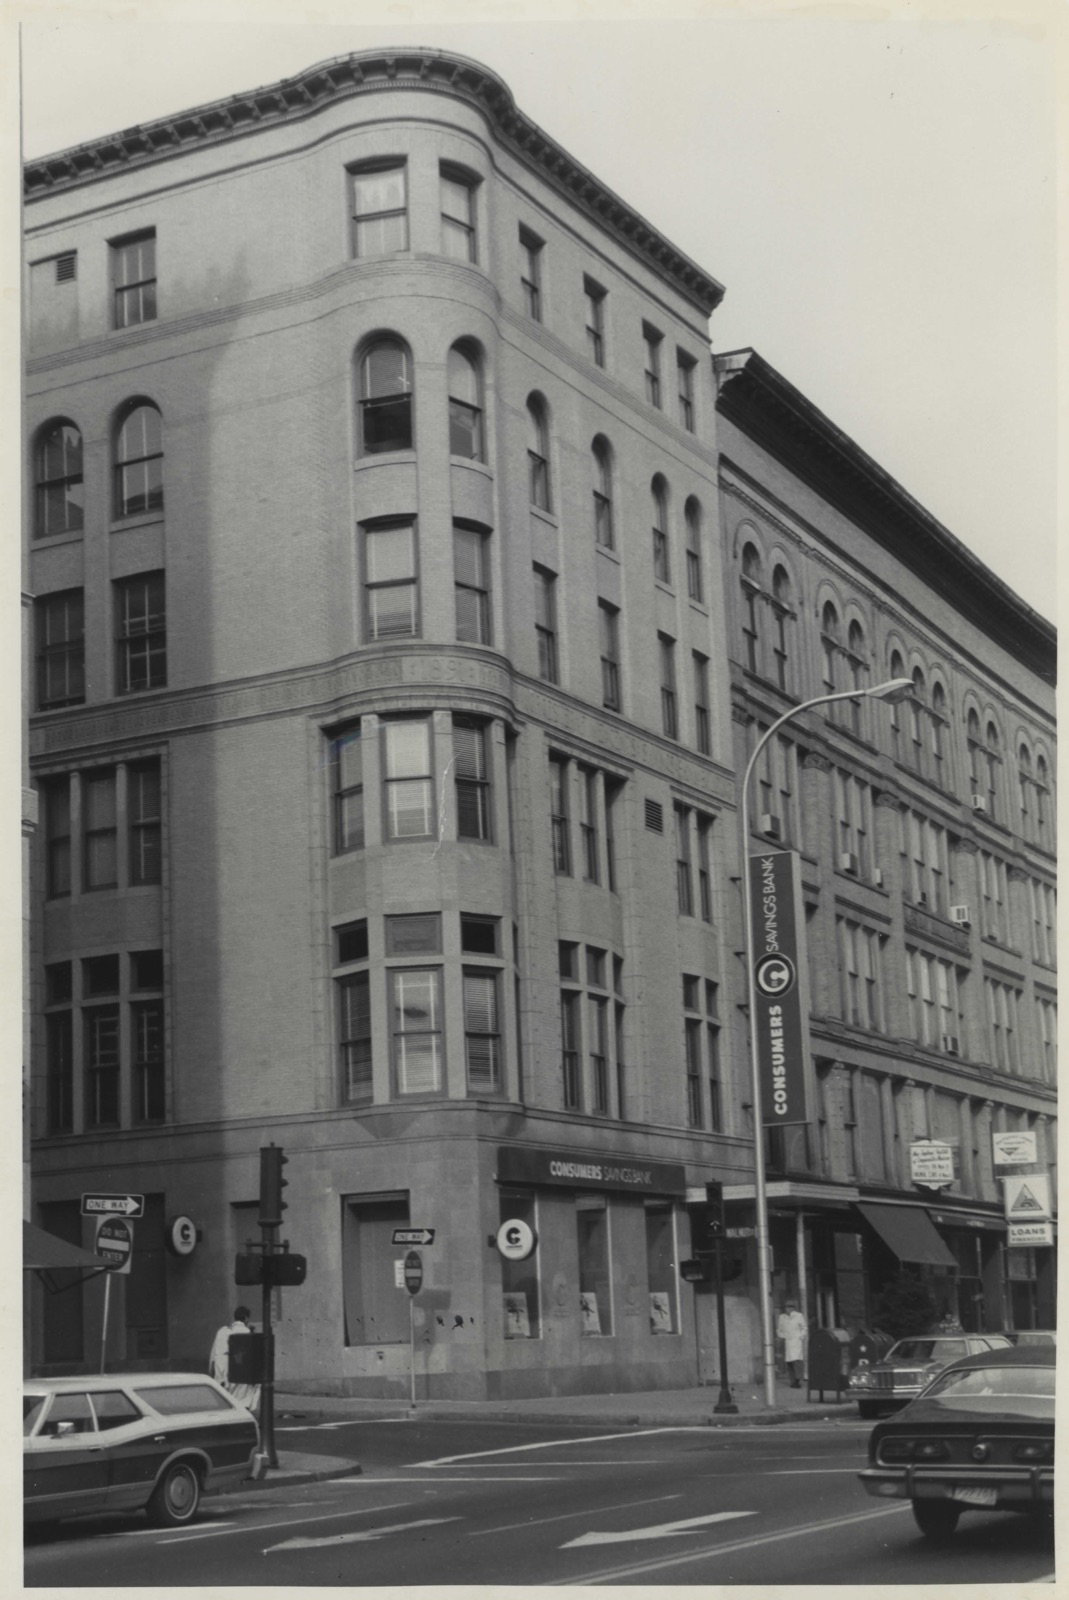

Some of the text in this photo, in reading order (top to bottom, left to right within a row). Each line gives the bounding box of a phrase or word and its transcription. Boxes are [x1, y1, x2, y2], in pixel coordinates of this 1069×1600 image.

[761, 857, 775, 894] BANK
[763, 895, 779, 952] SAVINGS
[769, 1005, 788, 1115] CONSUMERS
[550, 1160, 602, 1180] CONSUMERS
[88, 1200, 129, 1209] ONE WAY
[102, 1227, 128, 1238] DO NOT
[1011, 1228, 1046, 1236] LOANS
[103, 1251, 124, 1261] ENTER
